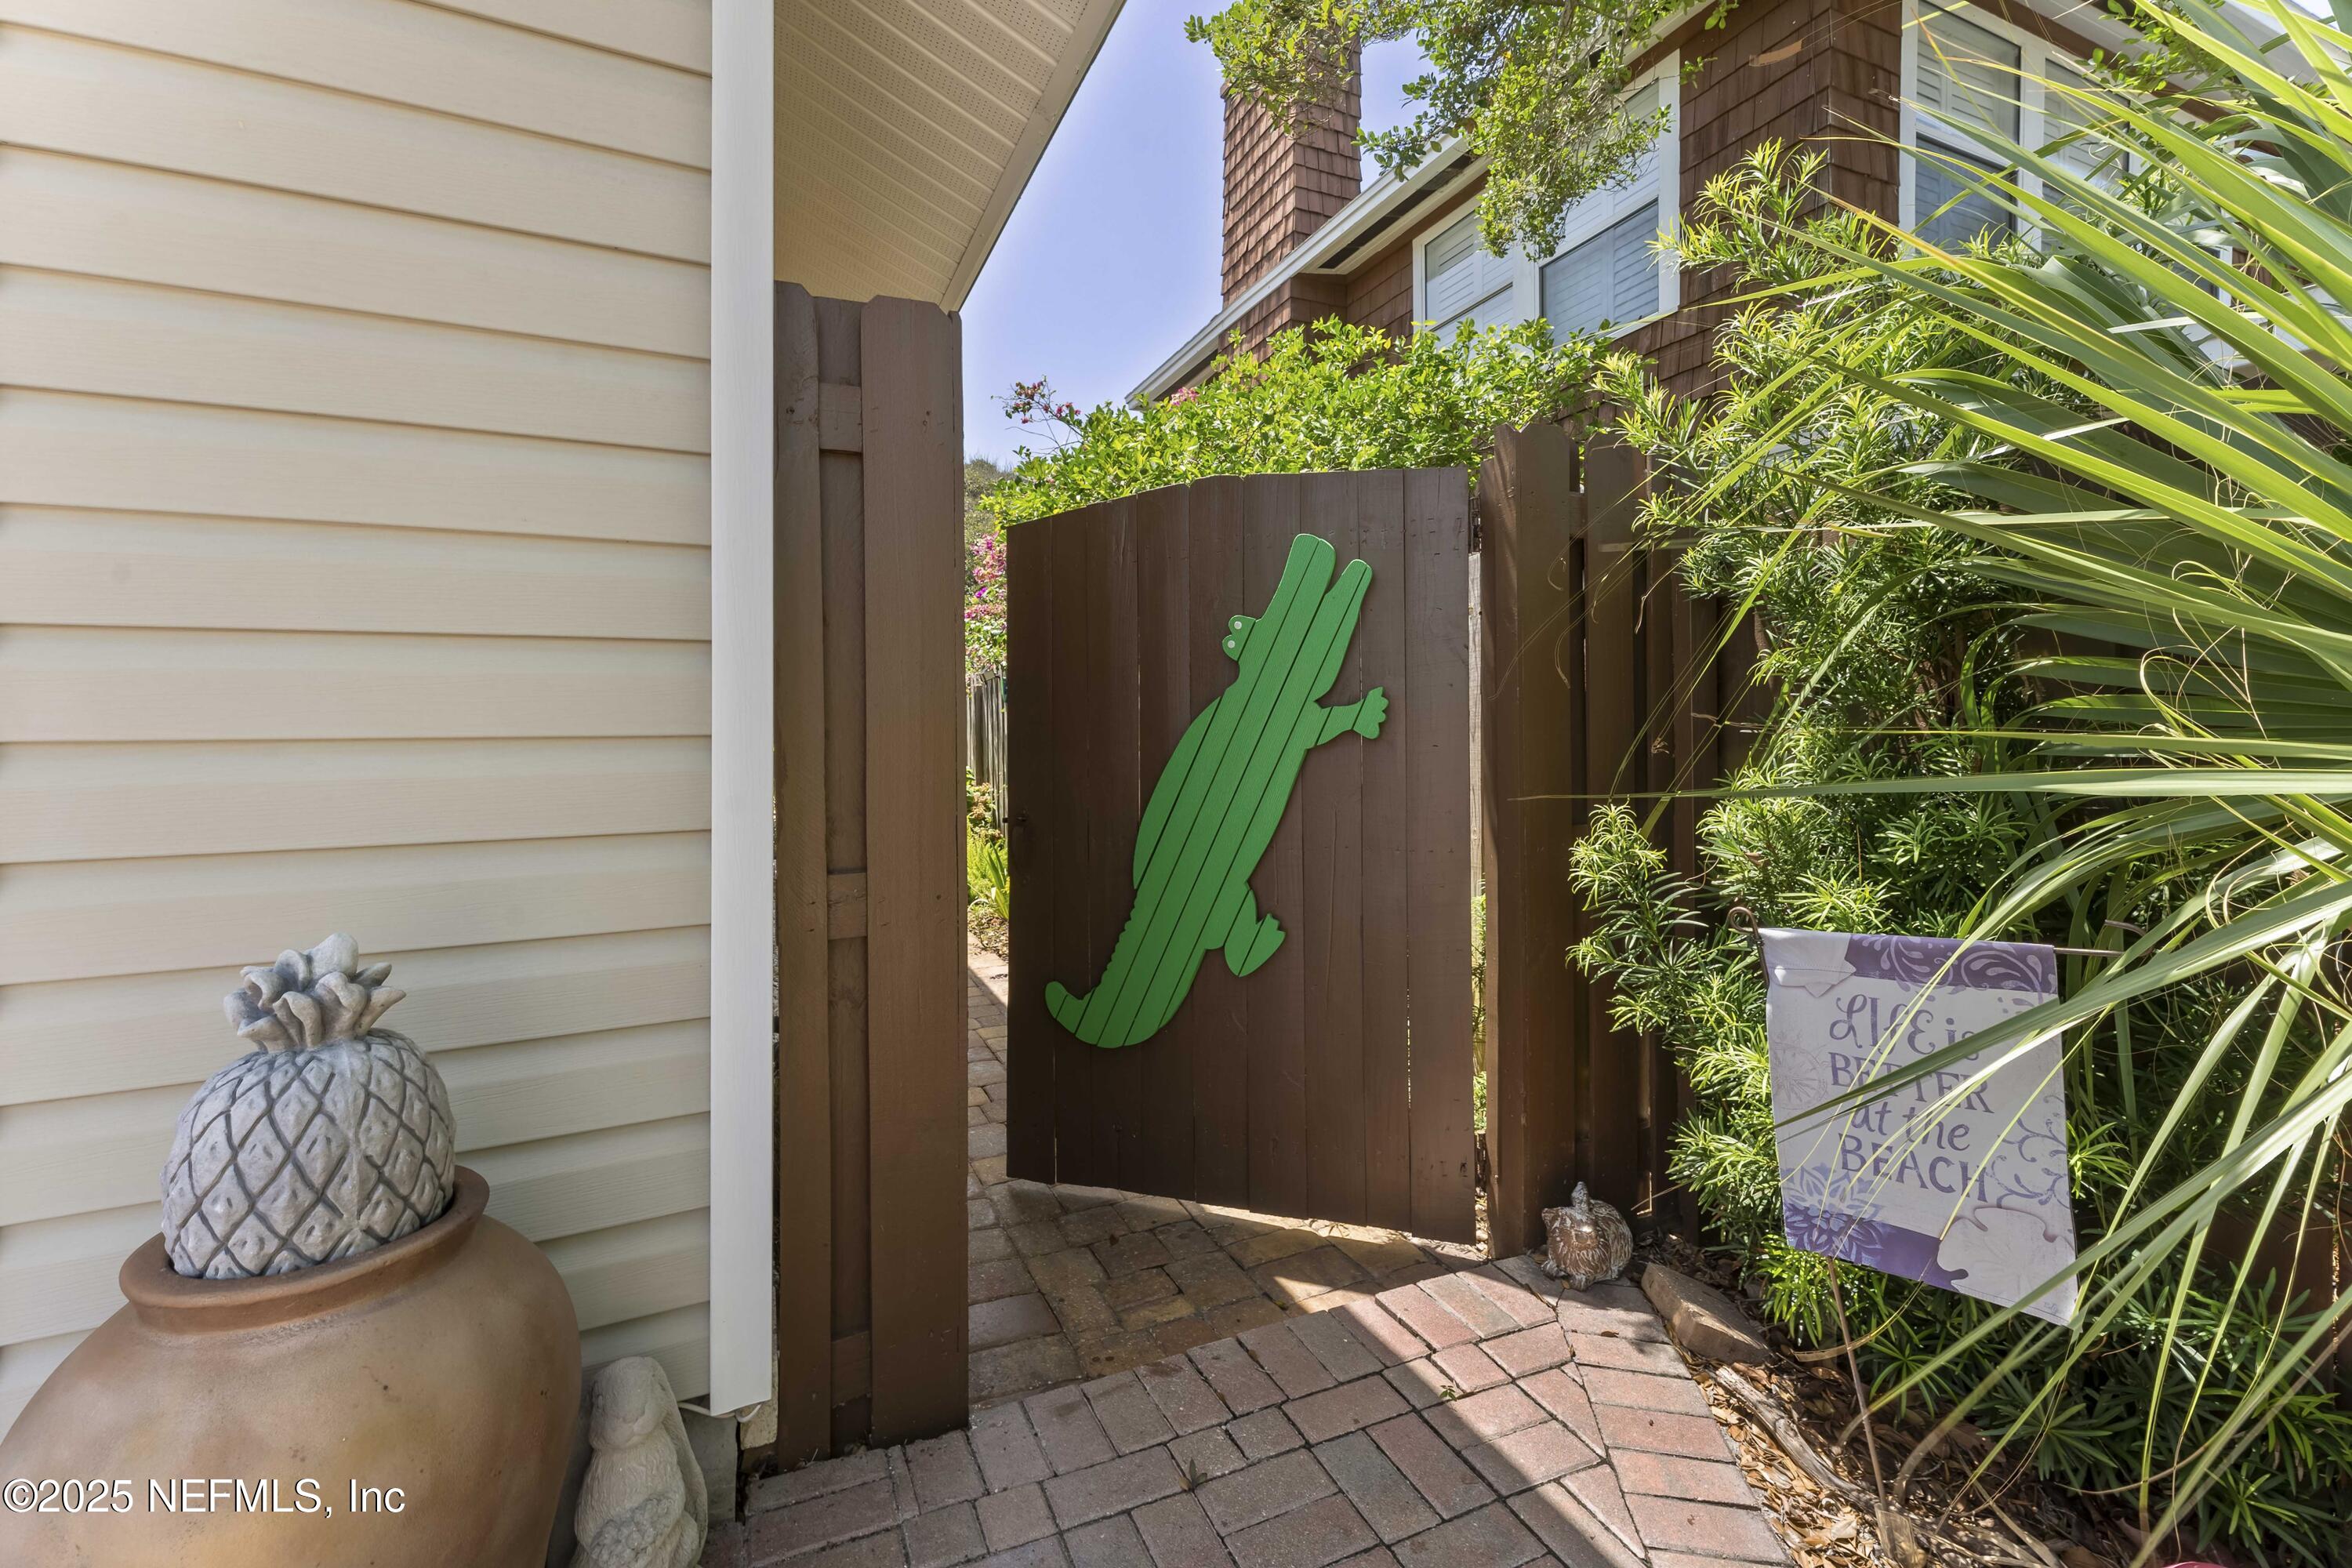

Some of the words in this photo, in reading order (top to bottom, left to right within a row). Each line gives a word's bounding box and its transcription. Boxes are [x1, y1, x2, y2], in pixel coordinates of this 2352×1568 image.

[1851, 1102, 1892, 1135] at
[1902, 1107, 1970, 1151] the
[1838, 1133, 1987, 1203] BEACH
